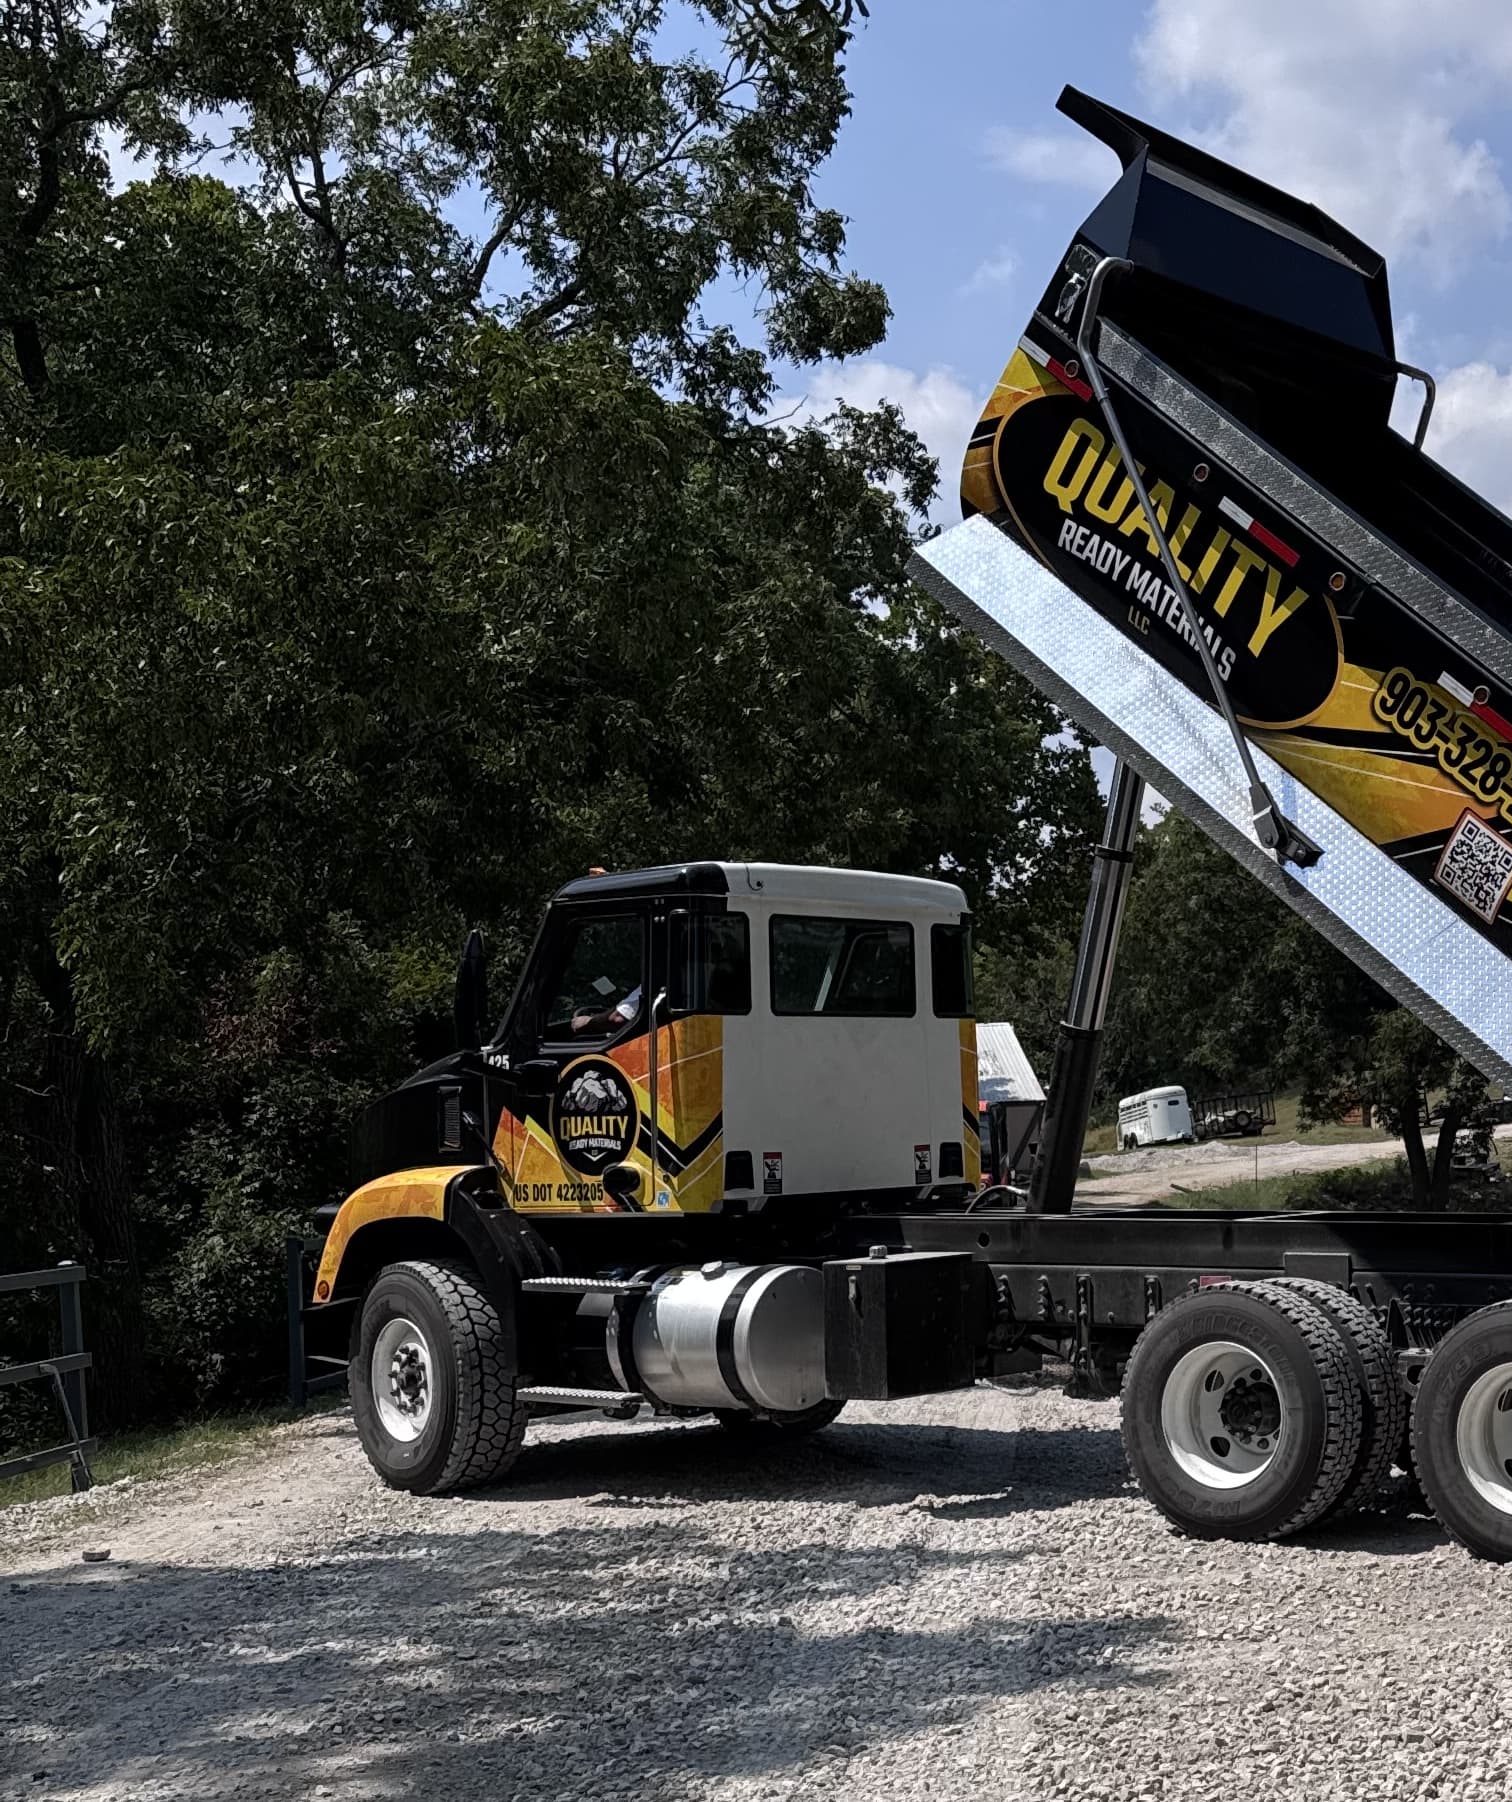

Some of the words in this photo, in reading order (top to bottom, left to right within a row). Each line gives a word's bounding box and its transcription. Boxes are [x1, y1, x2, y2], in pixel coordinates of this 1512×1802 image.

[1043, 417, 1309, 658] QUALITY
[1058, 518, 1125, 581] READY
[1128, 605, 1150, 635] LLC
[560, 1115, 629, 1141] QUALITY
[514, 1184, 529, 1202] US
[532, 1184, 553, 1202] DOT
[556, 1183, 603, 1201] 4223205
